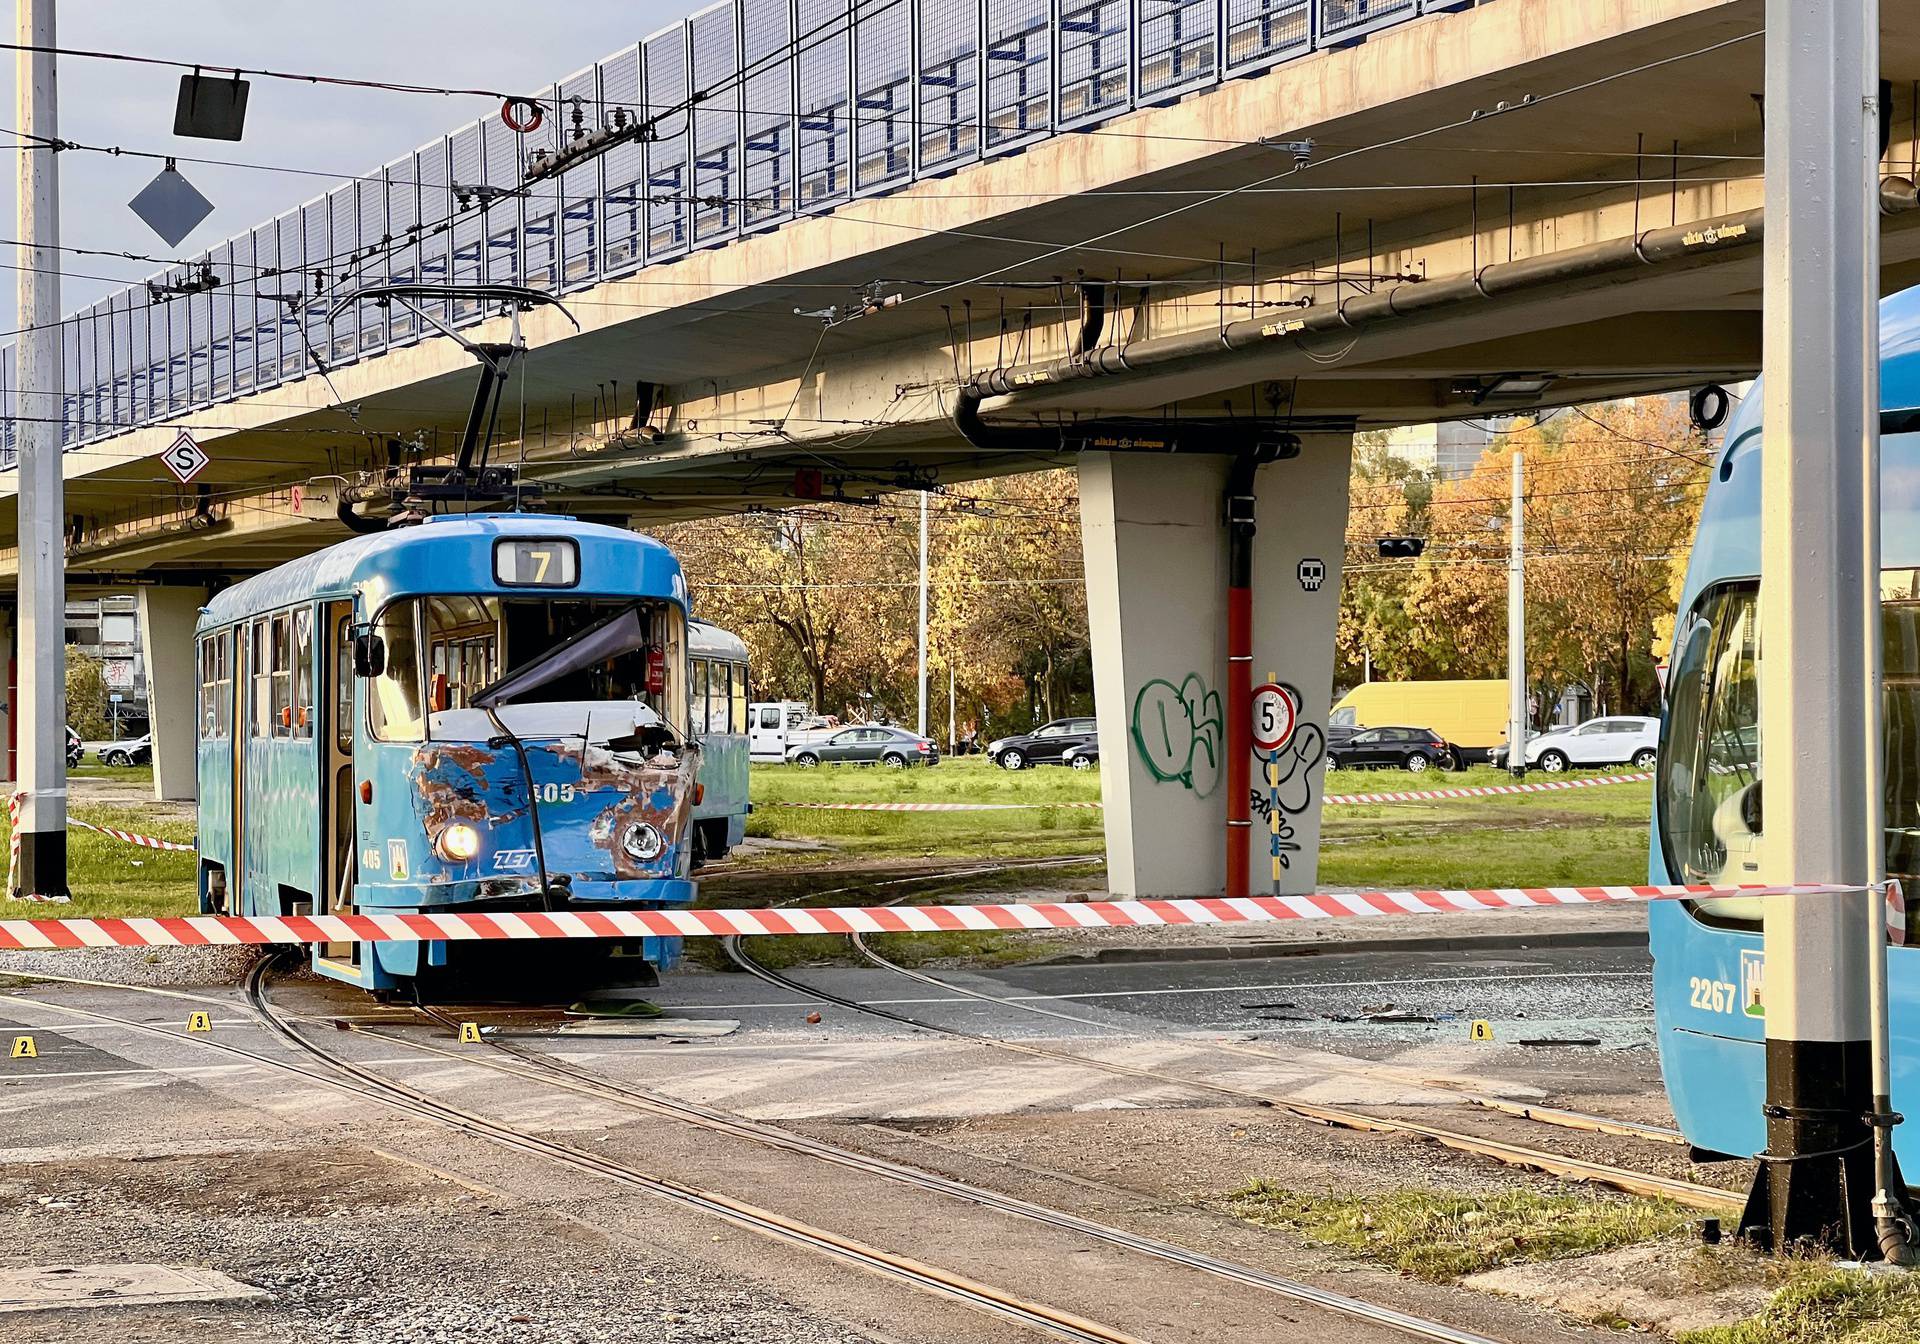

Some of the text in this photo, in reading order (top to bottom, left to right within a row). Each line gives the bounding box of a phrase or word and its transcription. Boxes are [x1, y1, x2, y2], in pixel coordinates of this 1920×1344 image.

[176, 447, 194, 470] S
[294, 489, 299, 510] S
[530, 551, 551, 583] 7
[1261, 702, 1274, 733] 5
[362, 849, 381, 870] 405
[1690, 976, 1736, 1014] 2267
[196, 1015, 206, 1028] 3.
[466, 1026, 476, 1040] 5.
[20, 1040, 32, 1054] 2.
